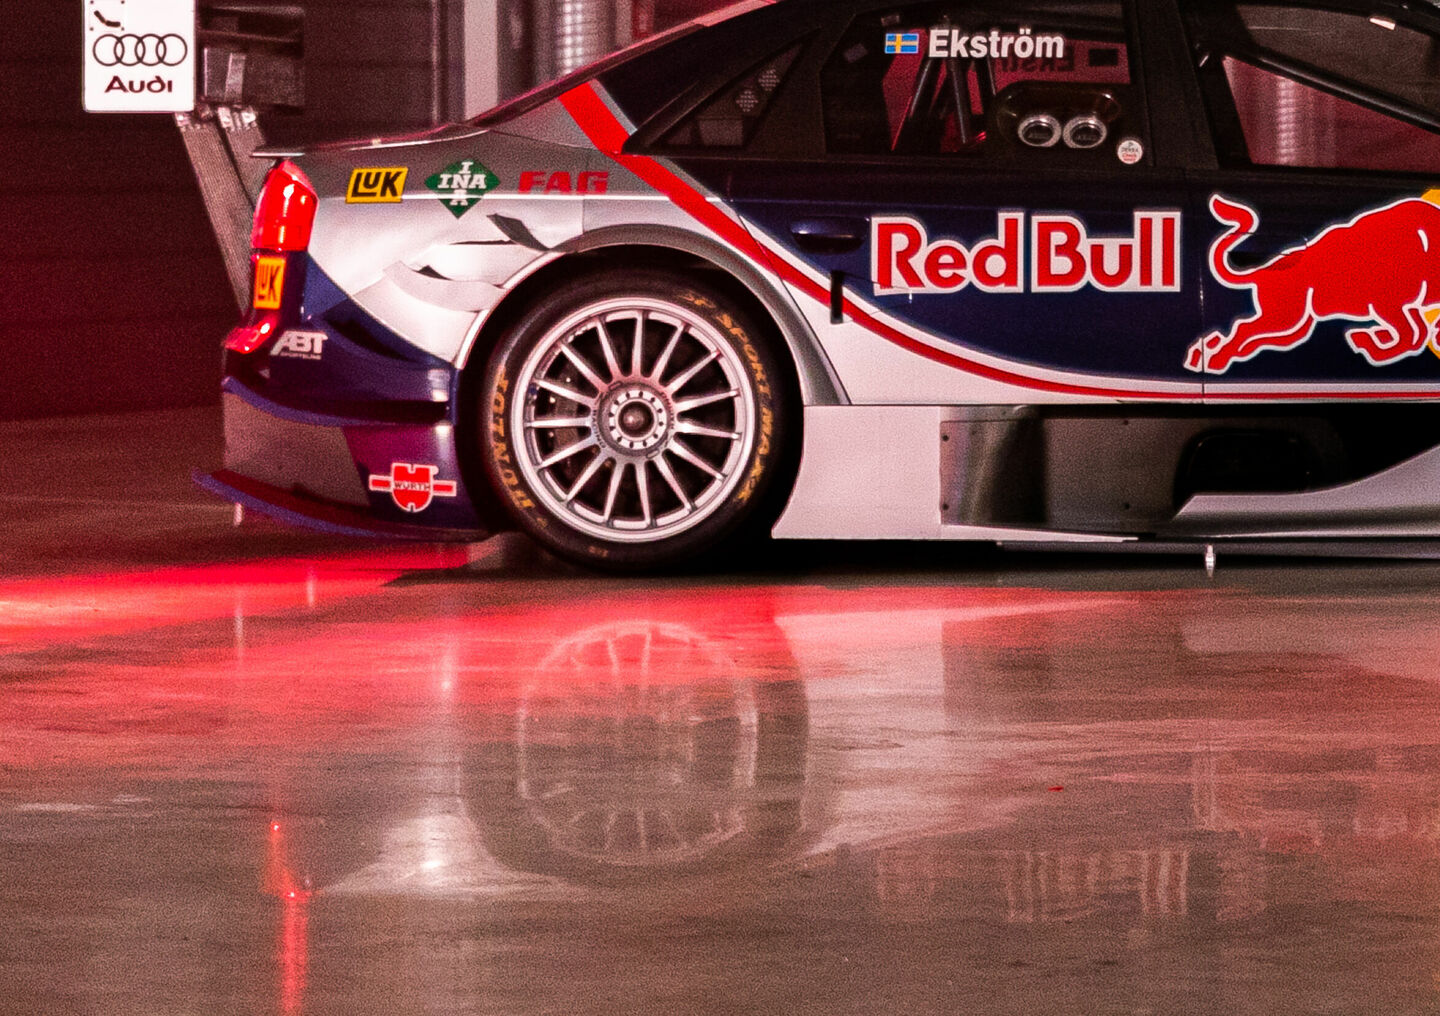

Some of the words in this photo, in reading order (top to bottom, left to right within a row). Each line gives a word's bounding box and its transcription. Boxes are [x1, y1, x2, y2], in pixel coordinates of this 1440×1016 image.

[928, 27, 1065, 60] Ekström
[104, 74, 174, 94] Audi
[518, 170, 610, 195] FAG
[871, 211, 1024, 295] Red
[1031, 211, 1181, 292] Bull
[269, 330, 328, 356] ABT
[490, 366, 535, 510] DUNLOP
